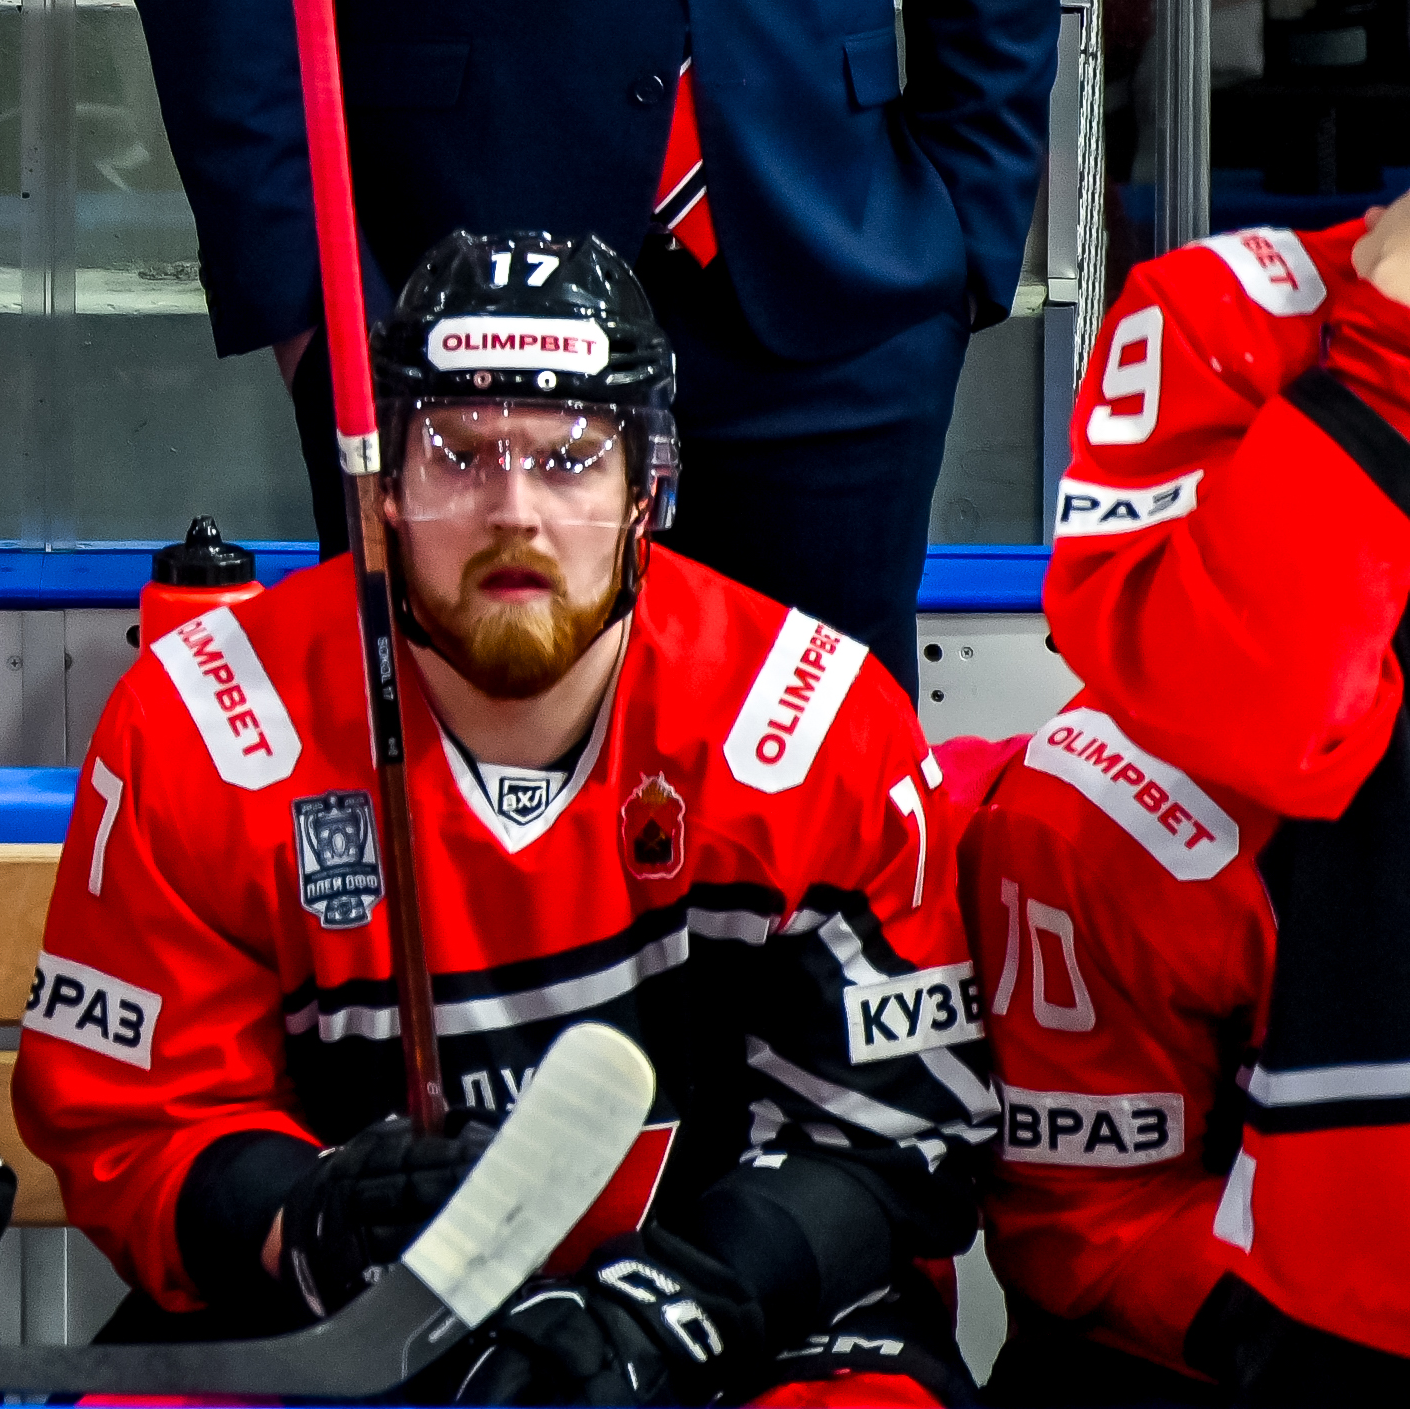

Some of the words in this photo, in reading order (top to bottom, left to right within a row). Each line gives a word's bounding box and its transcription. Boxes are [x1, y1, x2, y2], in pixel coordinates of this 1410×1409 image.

[490, 251, 560, 289] 17
[441, 332, 597, 357] OLIMPBET
[1047, 725, 1217, 851] OLIMPBET
[991, 877, 1097, 1033] 10
[1006, 1102, 1170, 1154] ВРАЗ
